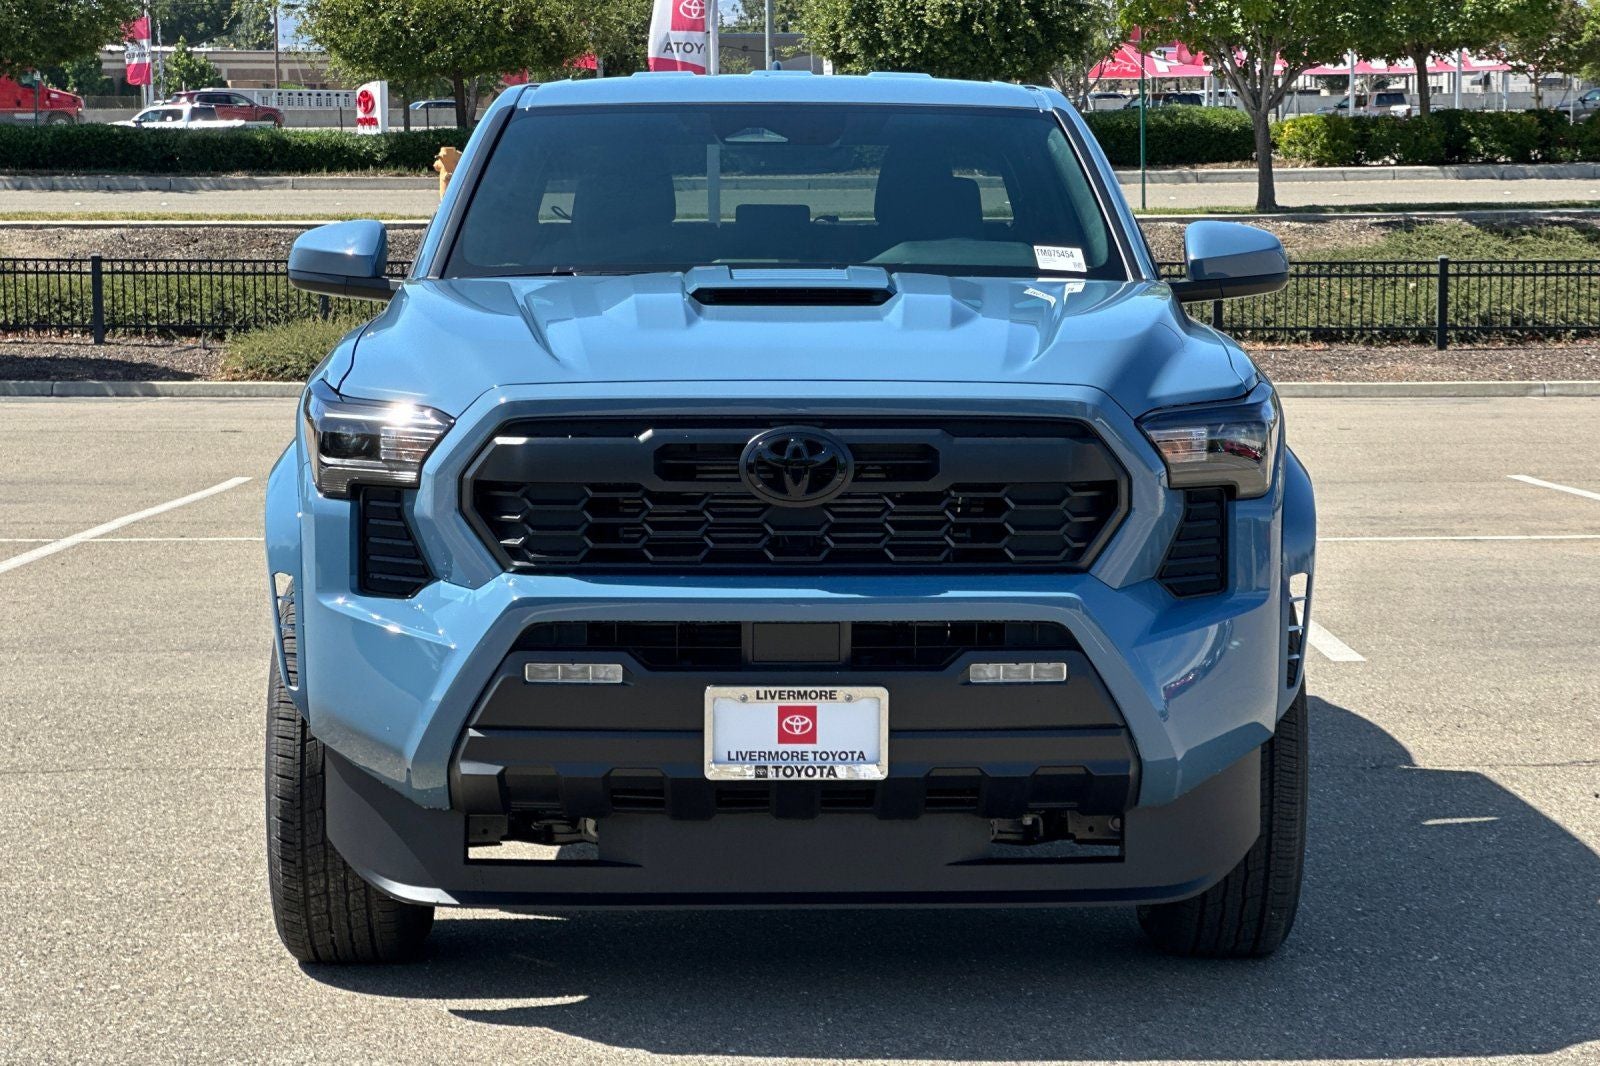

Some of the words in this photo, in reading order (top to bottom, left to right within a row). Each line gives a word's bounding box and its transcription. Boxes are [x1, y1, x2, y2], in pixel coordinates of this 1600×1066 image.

[756, 690, 837, 700] LIVERMORE
[728, 751, 809, 761] LIVERMORE
[811, 751, 866, 761] TOYOTA
[772, 765, 837, 778] TOYOTA
